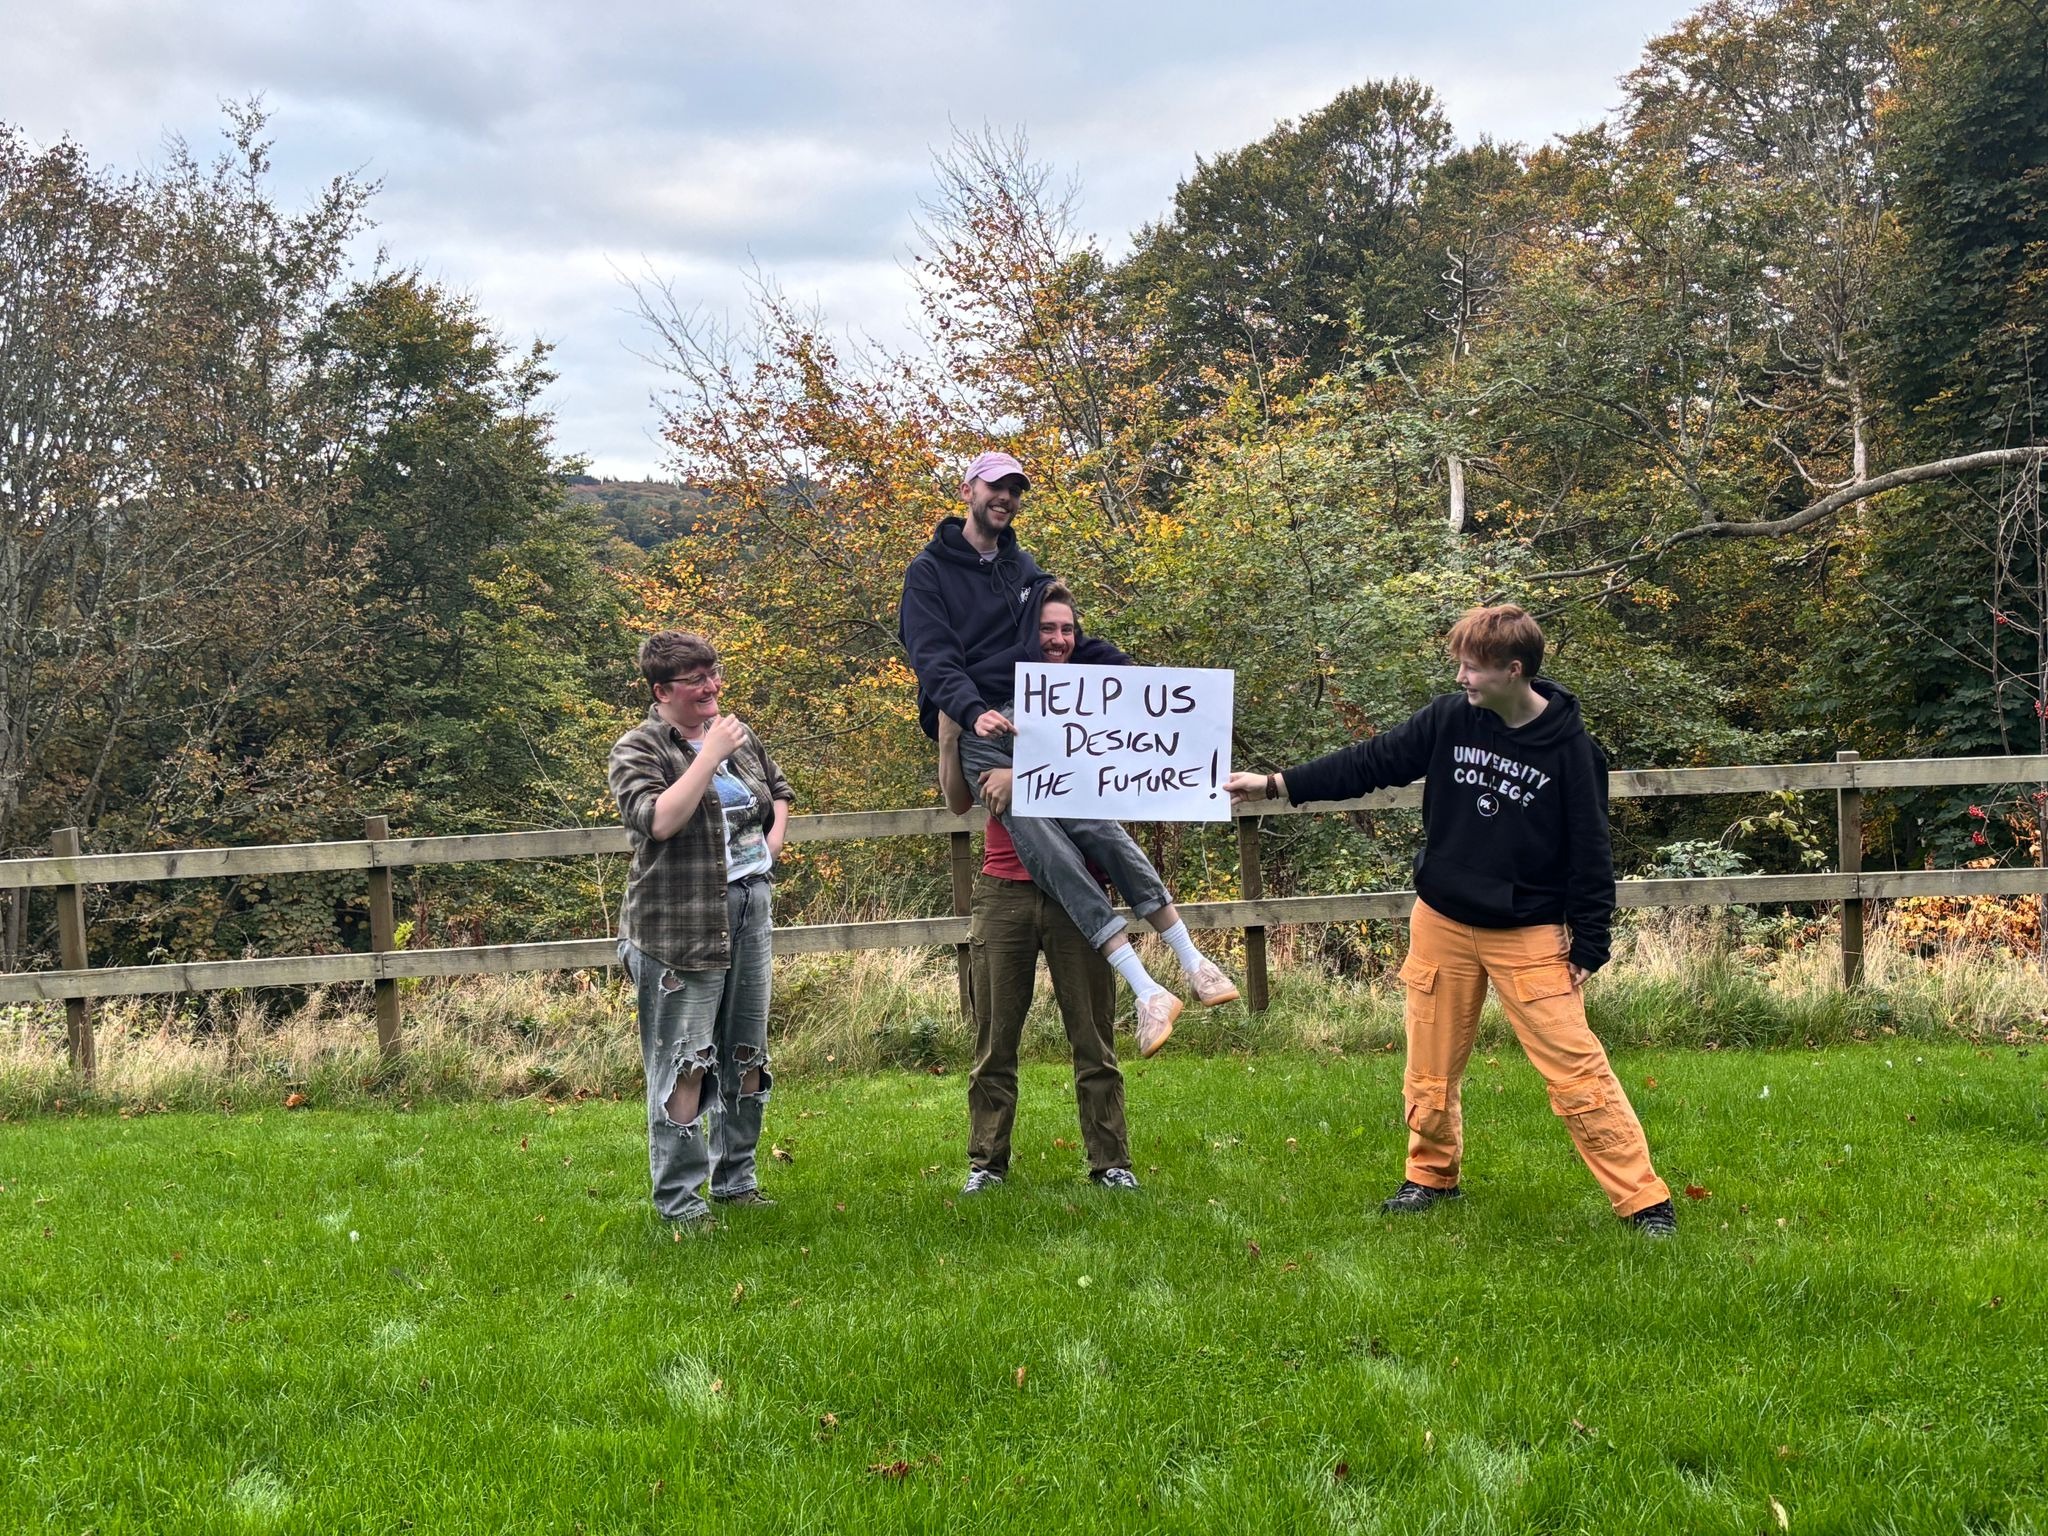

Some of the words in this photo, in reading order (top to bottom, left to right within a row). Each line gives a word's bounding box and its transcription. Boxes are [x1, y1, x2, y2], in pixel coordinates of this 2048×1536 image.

[1024, 672, 1123, 717] HELP
[1144, 684, 1196, 717] US
[1062, 722, 1180, 757] DESIGN
[1017, 763, 1076, 804] THE
[1453, 745, 1551, 790] UNIVERSITY
